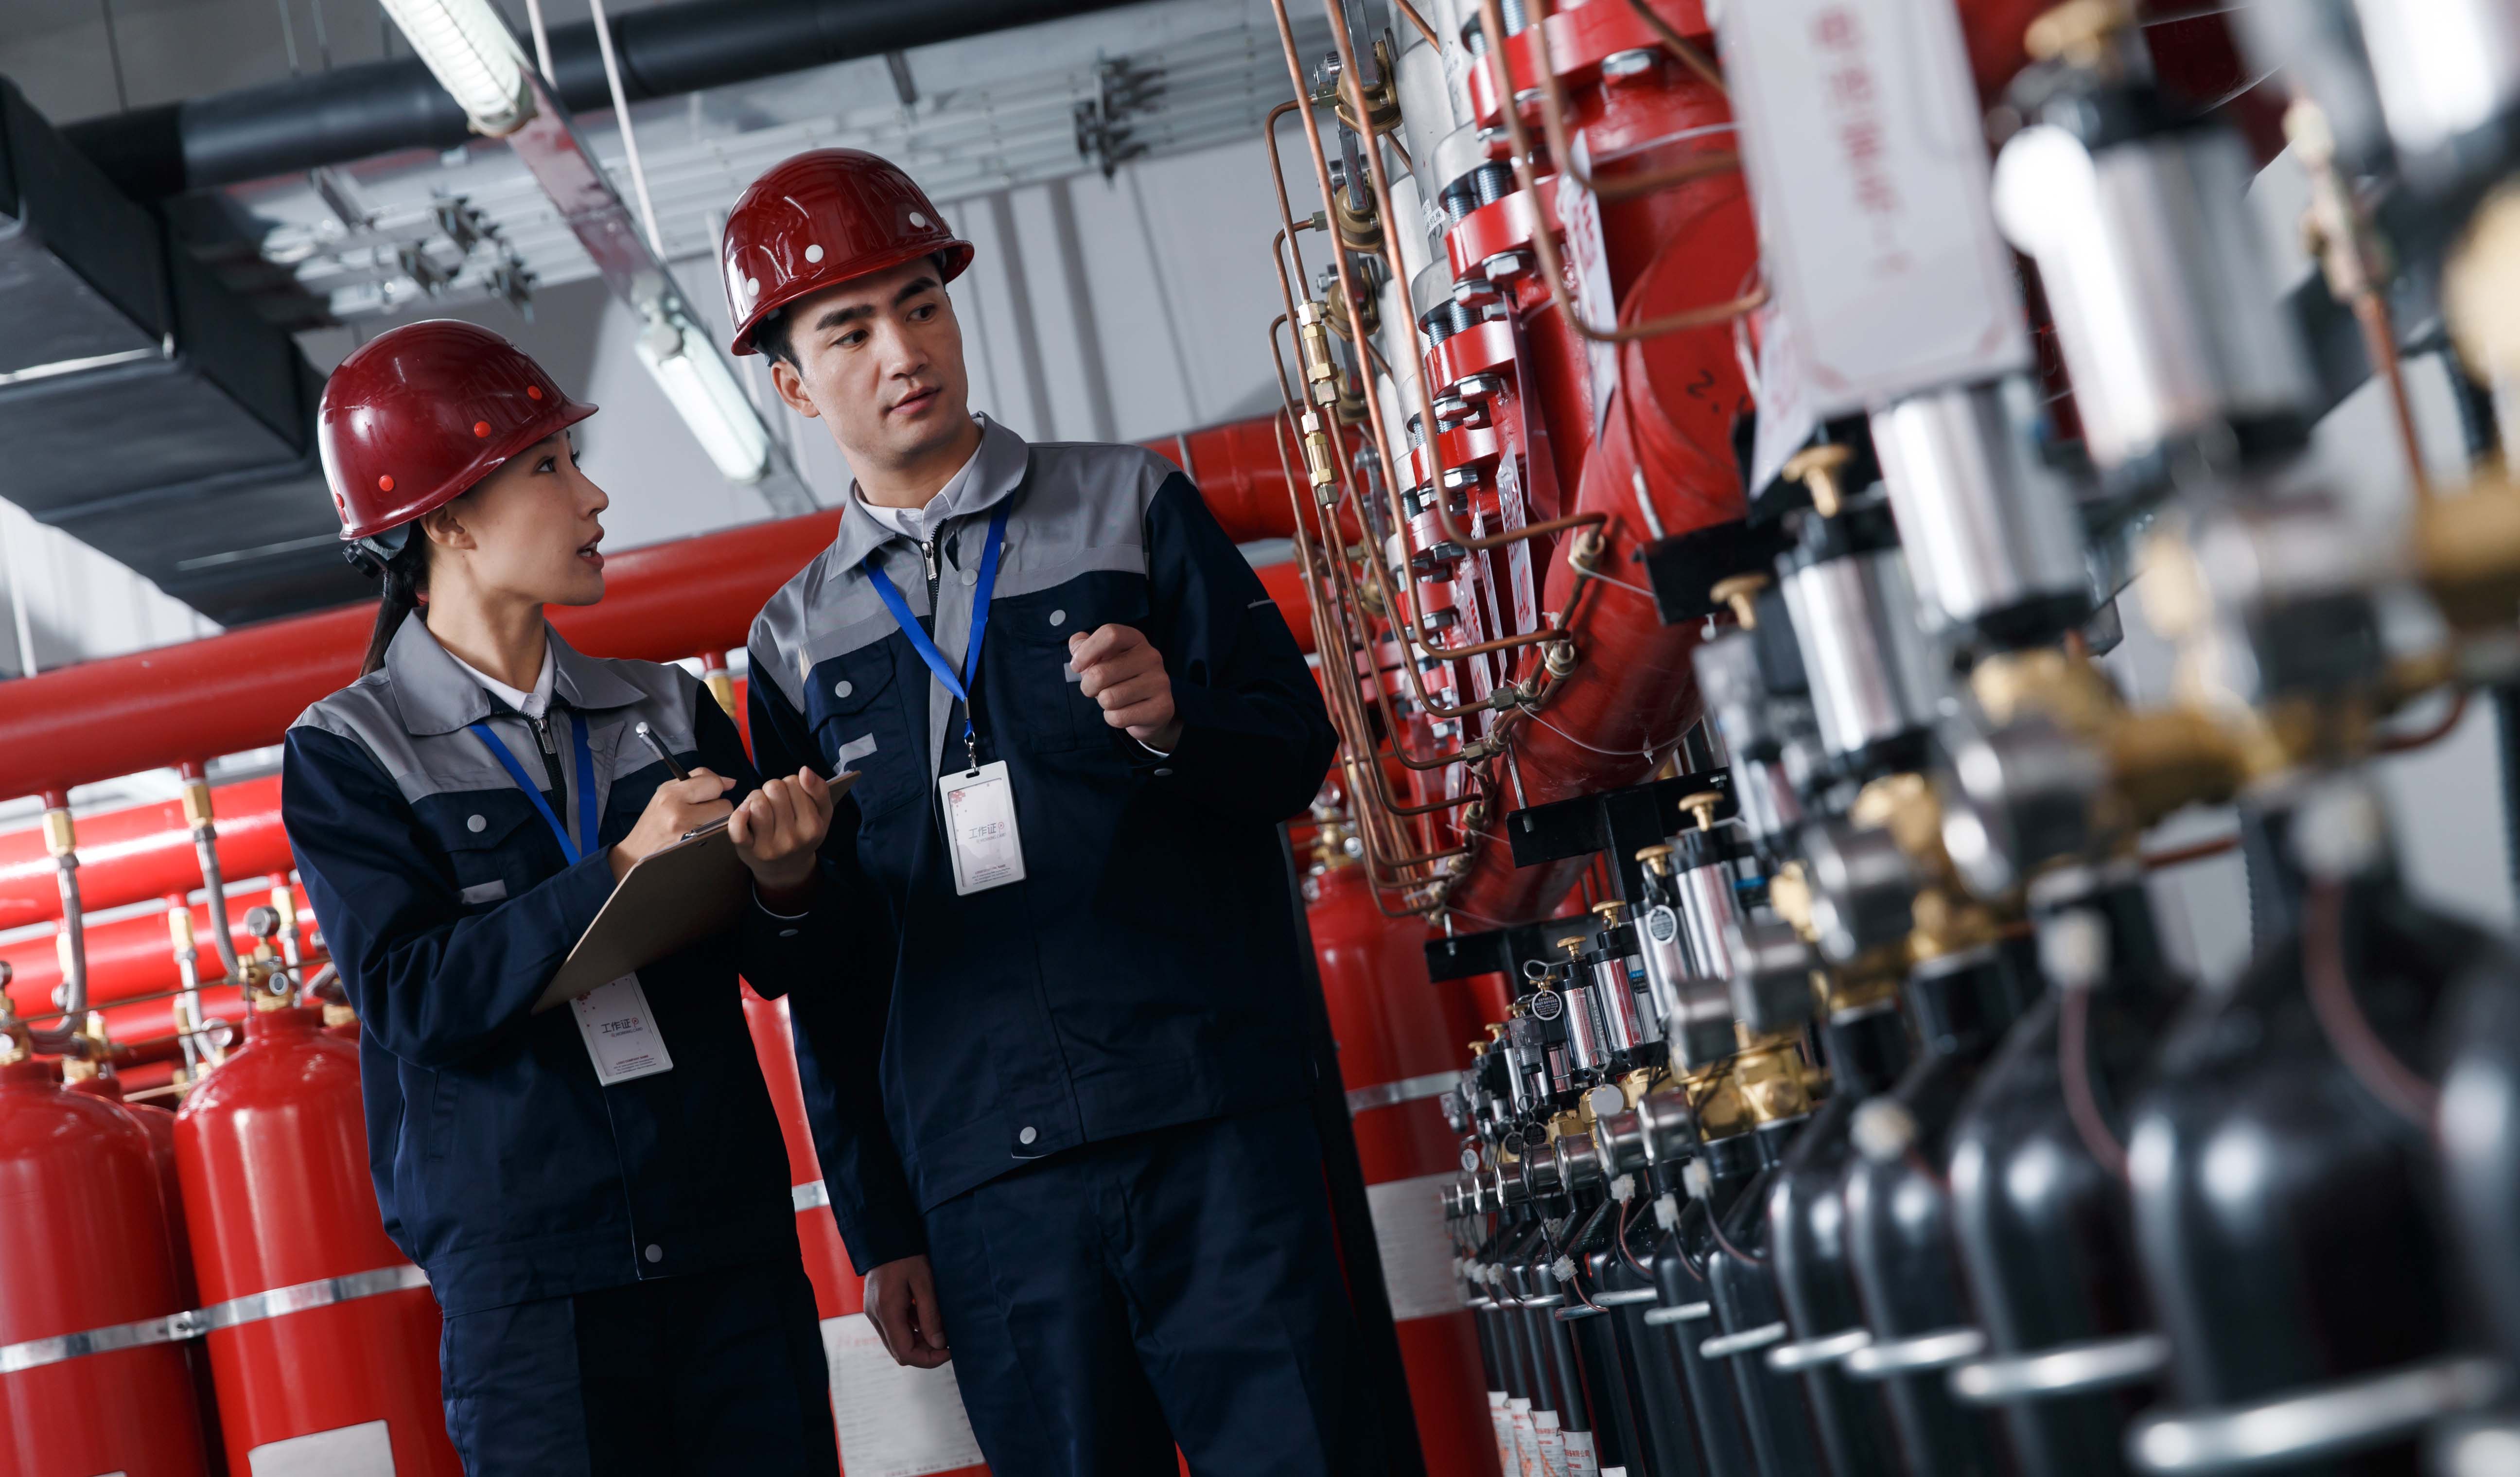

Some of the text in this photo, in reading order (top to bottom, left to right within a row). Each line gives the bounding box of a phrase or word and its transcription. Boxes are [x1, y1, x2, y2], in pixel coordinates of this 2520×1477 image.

[968, 823, 996, 839] 工作证
[601, 1018, 631, 1034] 工作证
